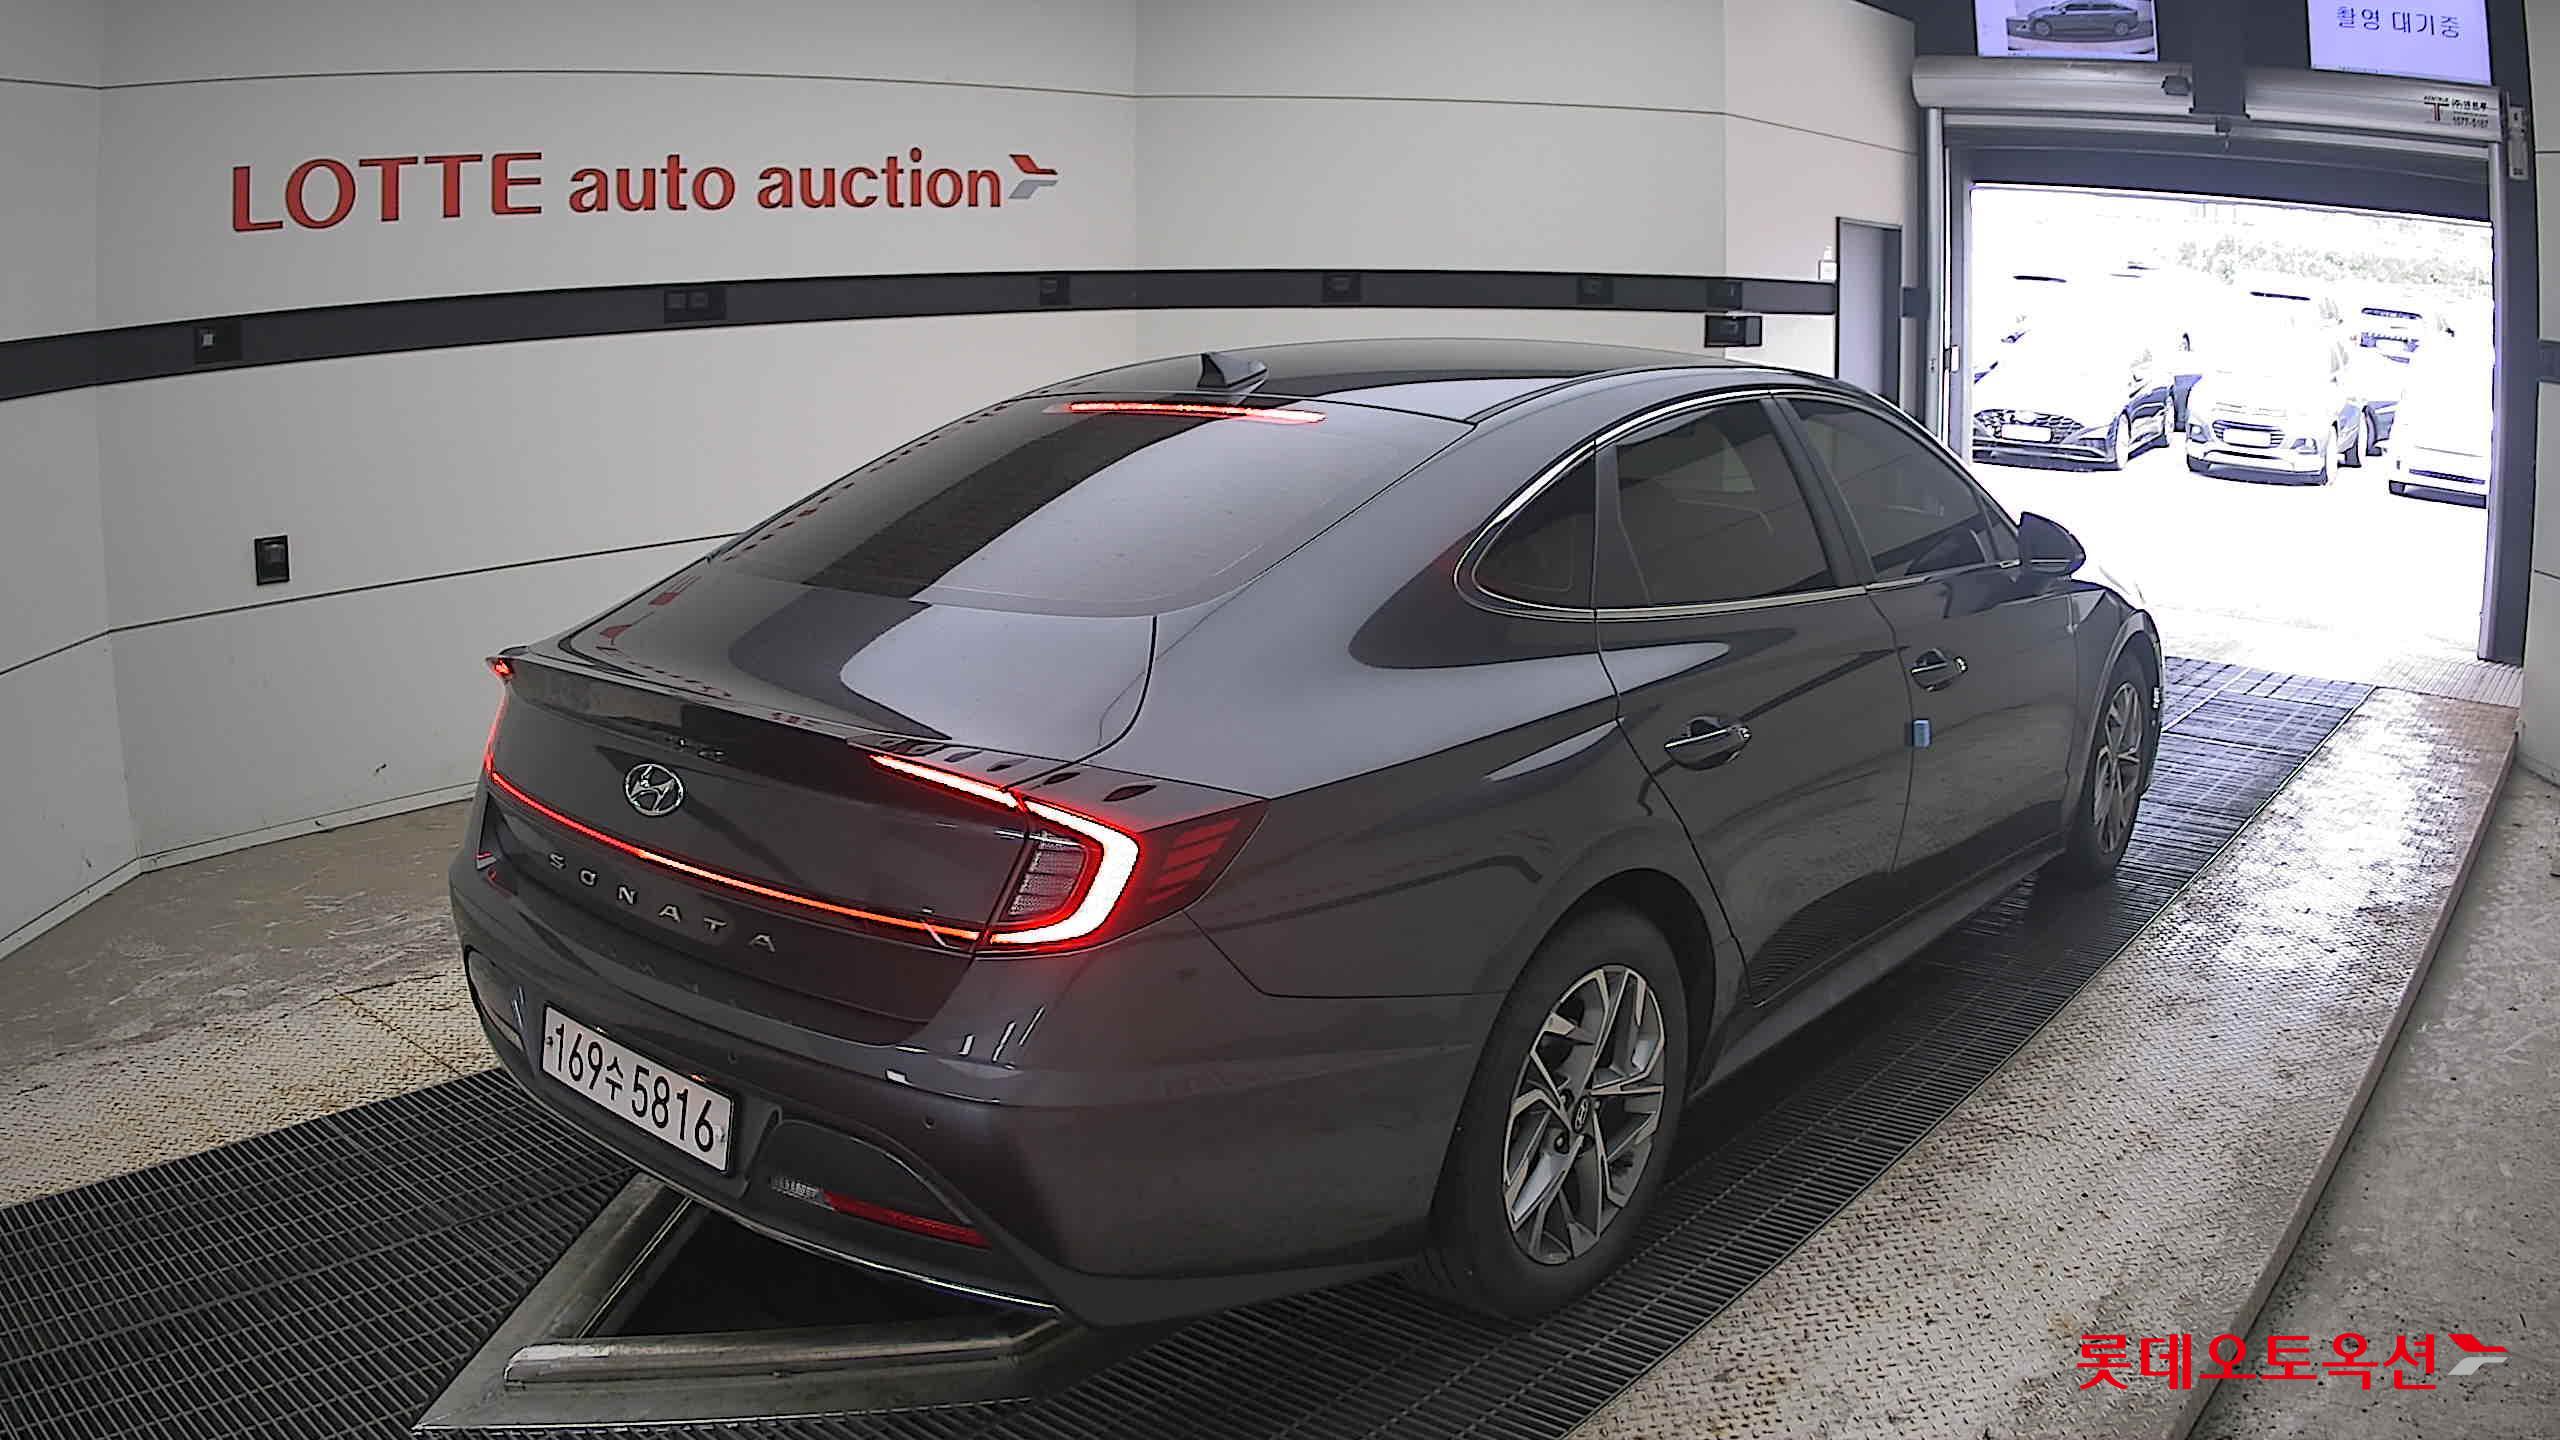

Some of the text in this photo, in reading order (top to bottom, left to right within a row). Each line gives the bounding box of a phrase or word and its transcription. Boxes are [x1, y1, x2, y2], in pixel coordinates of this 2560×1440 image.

[2336, 5, 2461, 39] 촬영 대기중
[232, 146, 1003, 232] LOTTE auto auction
[550, 852, 776, 952] SONATA
